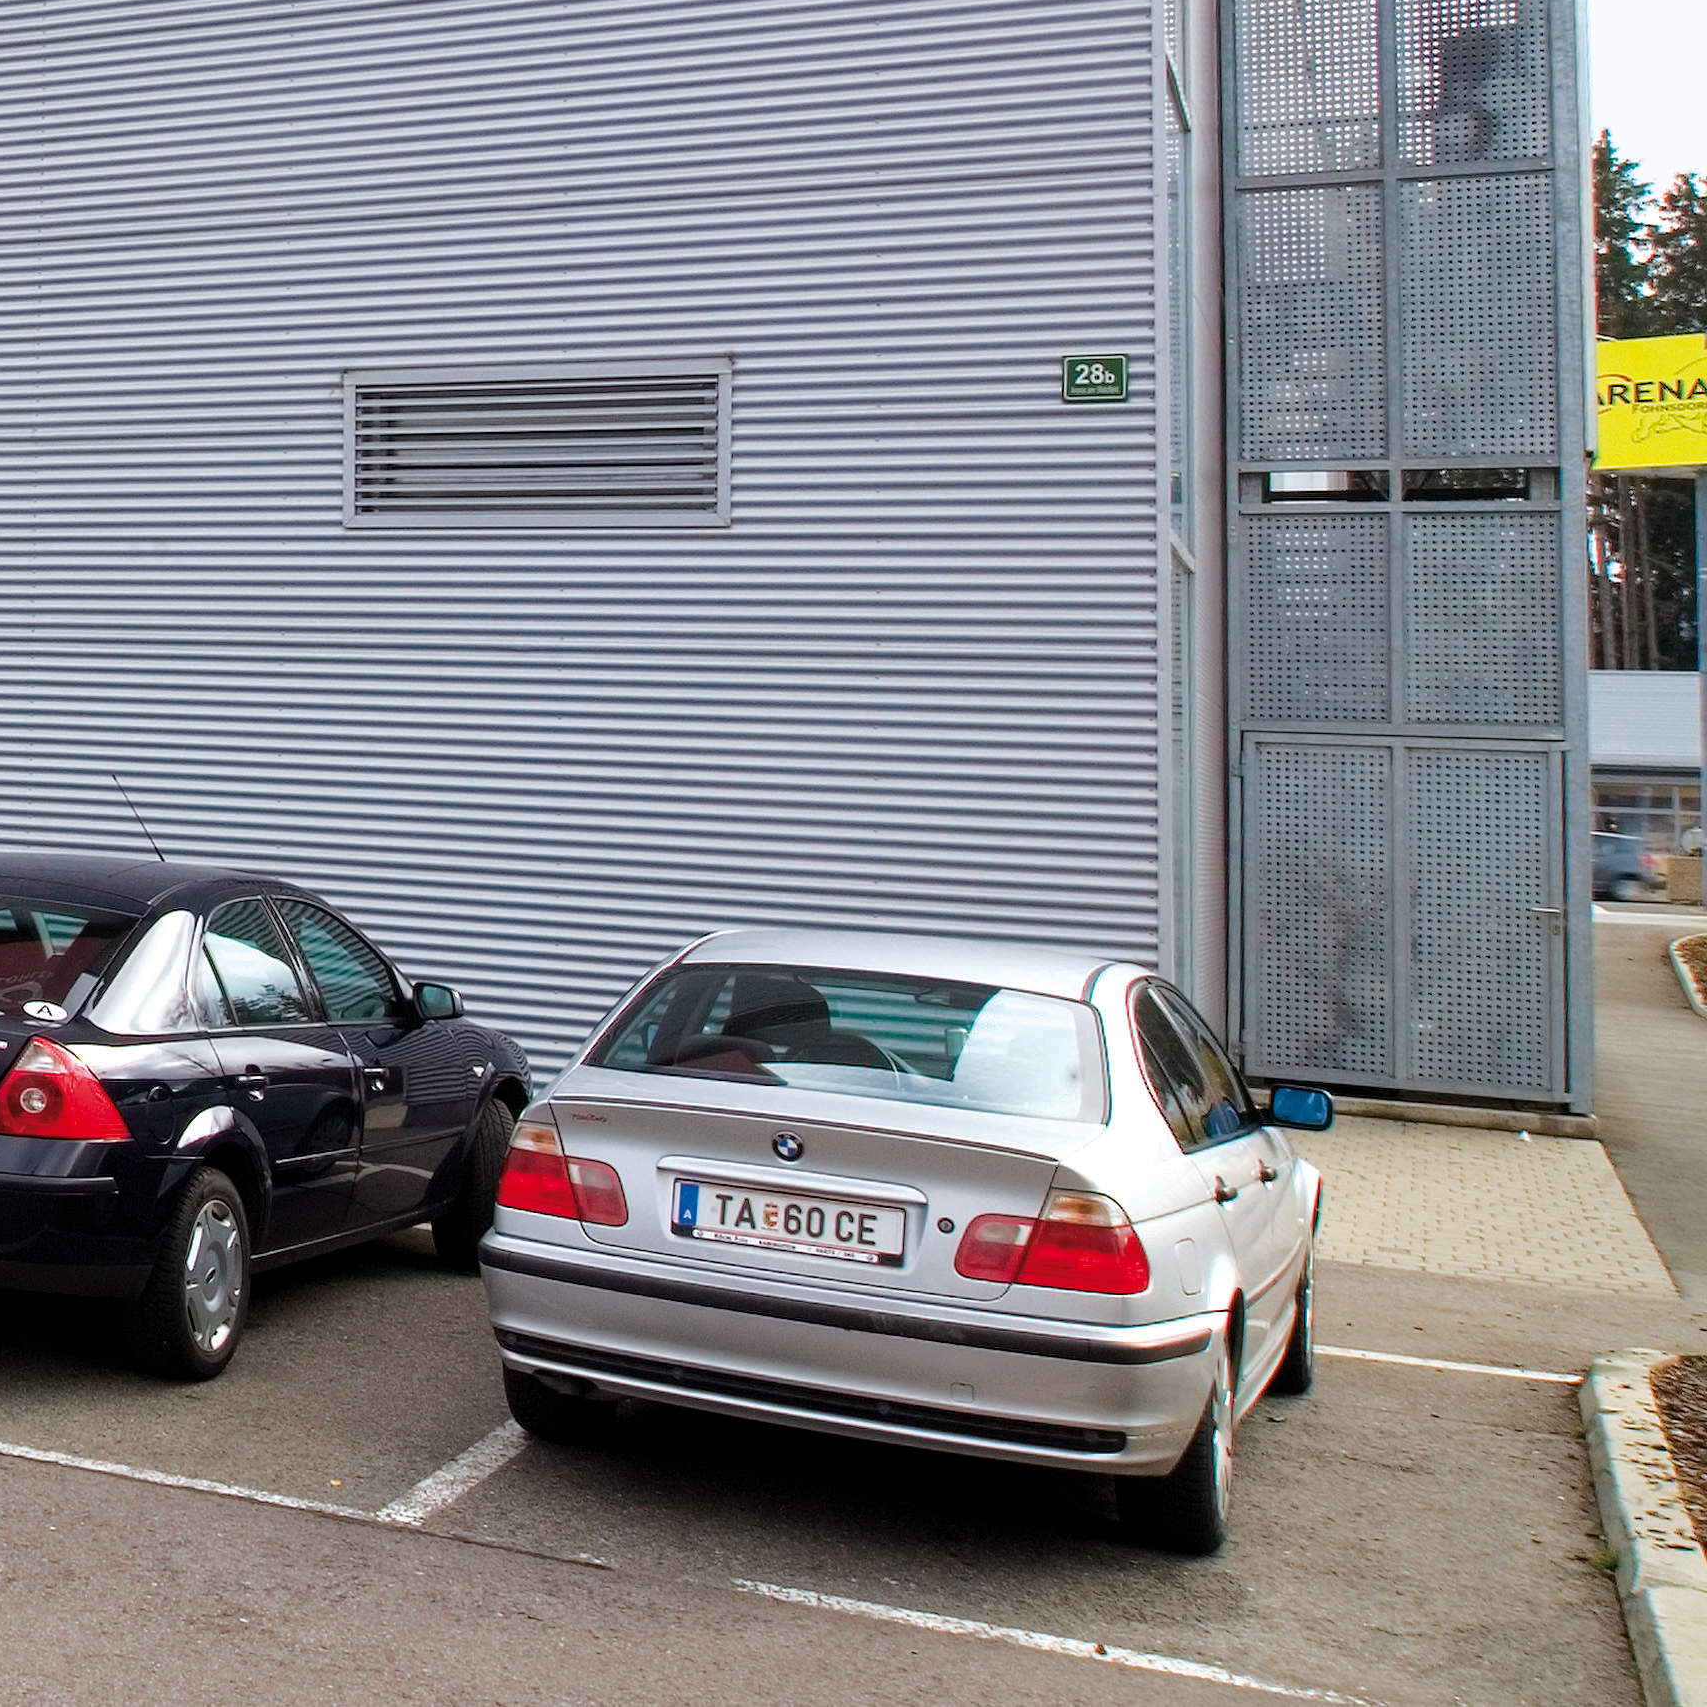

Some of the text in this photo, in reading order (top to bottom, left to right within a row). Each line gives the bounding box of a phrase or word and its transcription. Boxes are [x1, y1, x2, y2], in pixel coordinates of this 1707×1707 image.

[1075, 363, 1115, 385] 28b
[1597, 378, 1707, 405] RENA
[37, 1005, 53, 1017] A
[715, 1193, 756, 1230] TA
[784, 1203, 825, 1239] 60
[835, 1210, 878, 1246] CE
